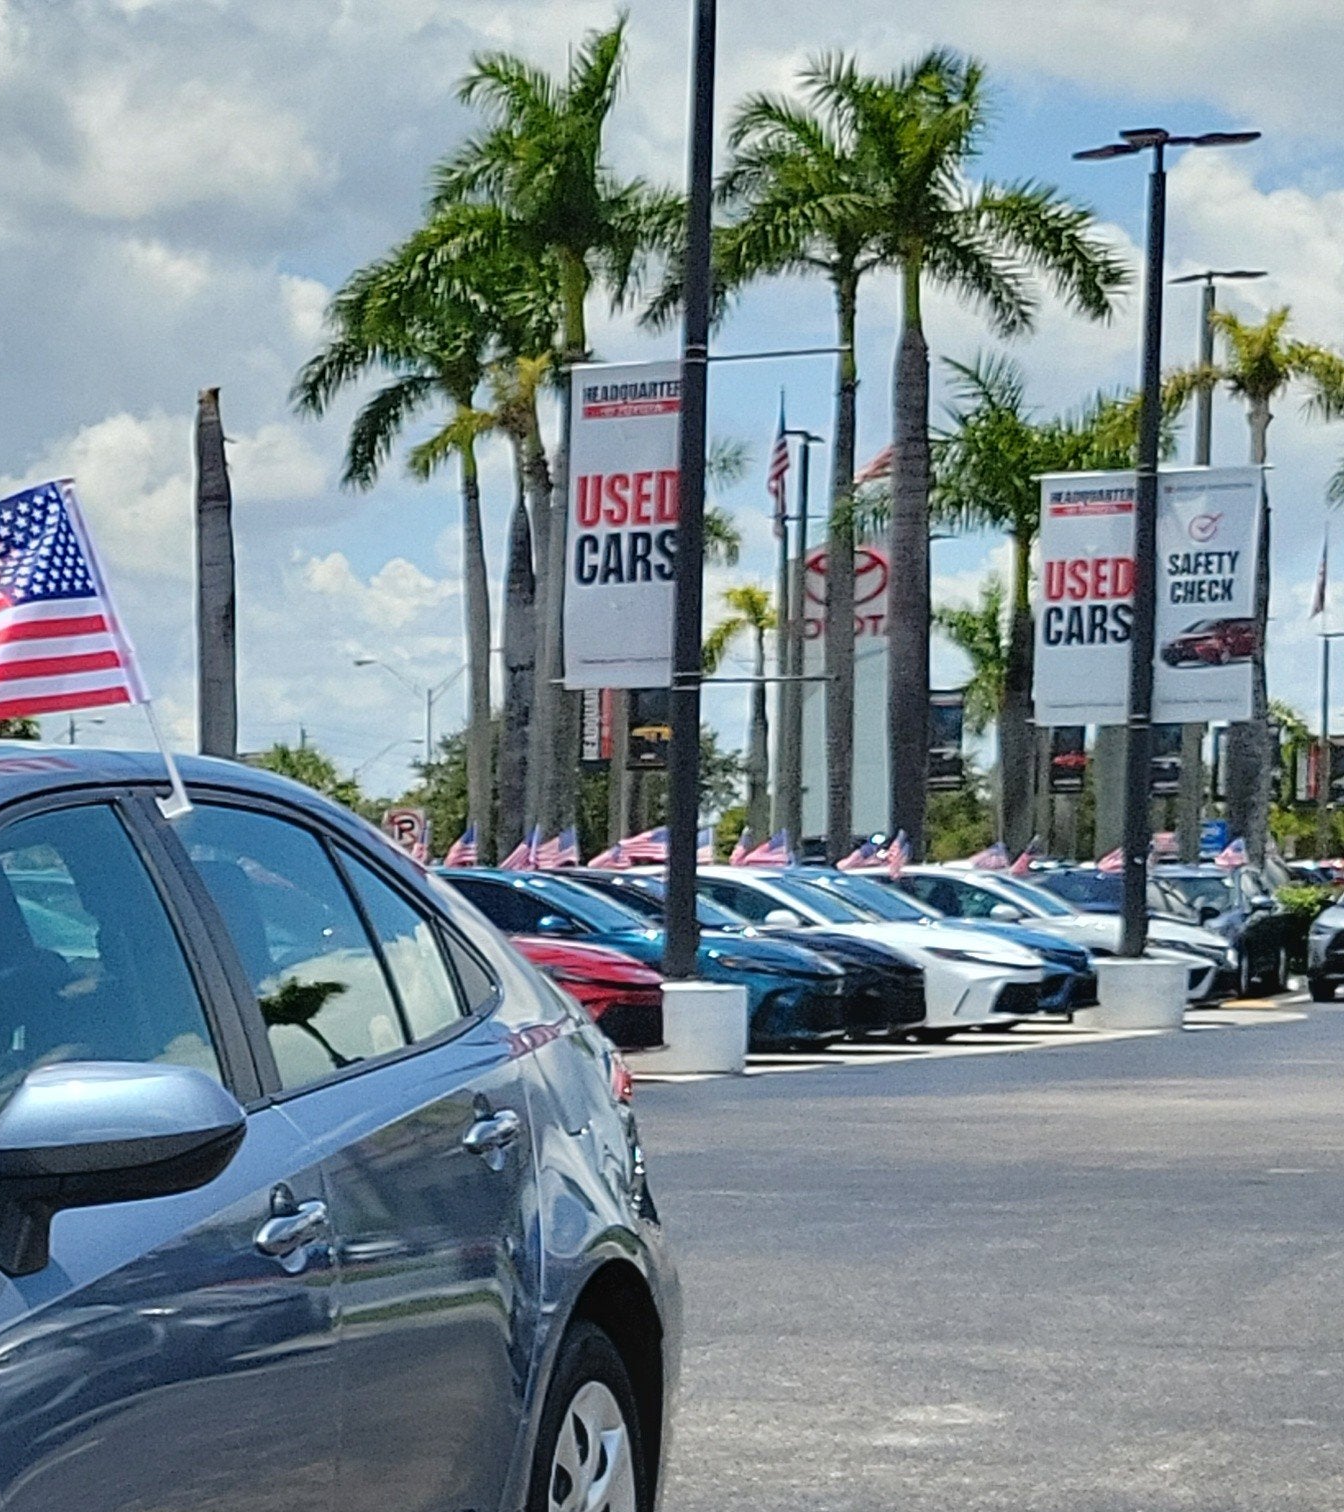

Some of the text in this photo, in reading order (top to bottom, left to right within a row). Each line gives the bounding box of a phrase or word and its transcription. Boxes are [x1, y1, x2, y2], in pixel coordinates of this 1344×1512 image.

[577, 470, 681, 528] USED
[576, 529, 678, 585] CARS
[1169, 551, 1239, 576] SAFETY
[1046, 558, 1136, 600] USED
[1171, 578, 1234, 604] CHECK
[1045, 605, 1133, 645] CARS
